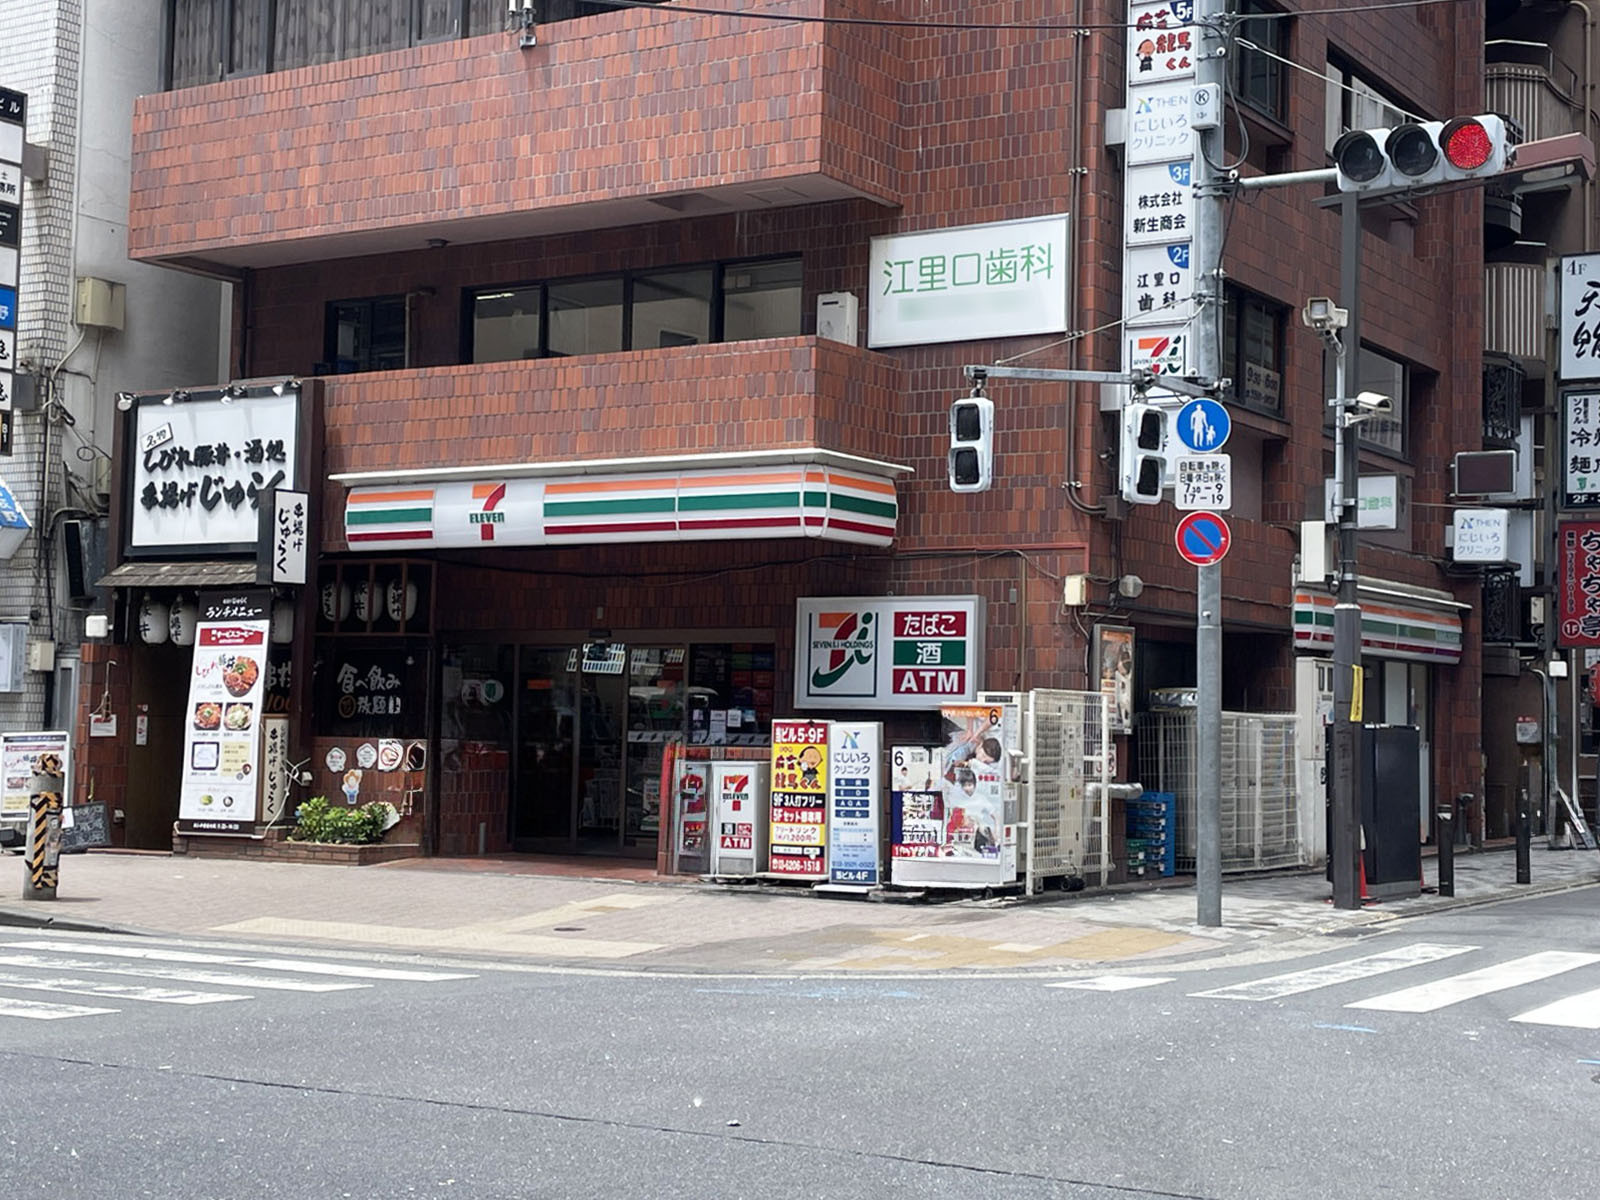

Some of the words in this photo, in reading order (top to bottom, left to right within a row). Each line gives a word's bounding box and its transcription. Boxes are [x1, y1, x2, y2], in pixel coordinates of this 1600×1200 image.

[1176, 2, 1192, 20] 5F
[1166, 56, 1191, 70] くん
[1156, 95, 1189, 108] THEN
[1134, 114, 1187, 133] にじいろ
[1132, 132, 1189, 150] クリニック
[1172, 166, 1189, 182] 3F
[1138, 191, 1183, 210] 株式会社
[1133, 213, 1186, 233] 新生商会
[1173, 247, 1189, 263] 2F
[883, 243, 1054, 295] 江里口歯科
[1566, 260, 1587, 275] 4F
[1137, 272, 1181, 288] 江里口
[1476, 518, 1500, 527] THEN
[276, 508, 291, 574] じゅらく
[1459, 533, 1500, 543] にじいろ
[1457, 545, 1501, 555] クリニック
[206, 606, 262, 618] ランチメニュー
[904, 614, 957, 635] たばこ
[916, 642, 942, 664] 酒
[337, 663, 401, 693] 食べ飲み
[900, 671, 958, 692] ATM
[834, 753, 871, 763] にじいろ
[894, 750, 904, 767] 6
[834, 766, 871, 775] クリニック
[723, 837, 750, 848] ATM
